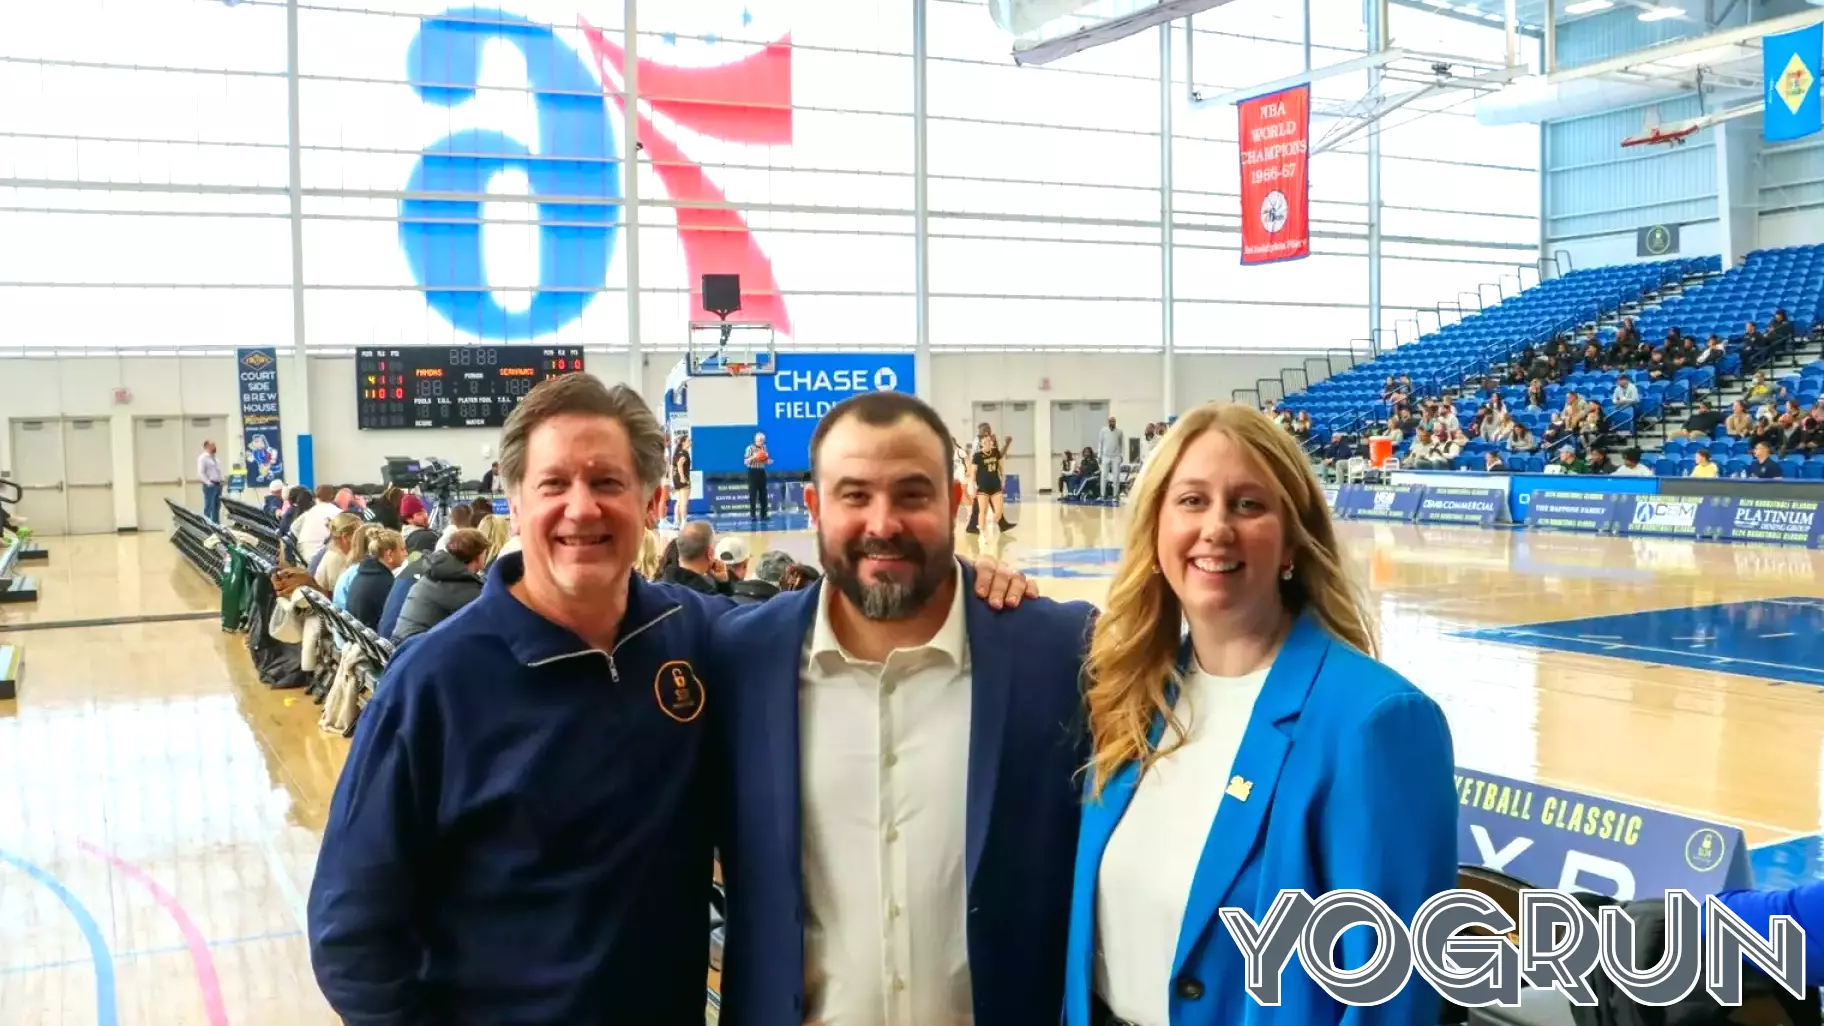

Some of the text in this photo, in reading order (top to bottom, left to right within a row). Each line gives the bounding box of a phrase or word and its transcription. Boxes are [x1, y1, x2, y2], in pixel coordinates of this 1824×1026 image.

[1260, 101, 1286, 120] NBA
[1251, 121, 1296, 142] WORLD
[1241, 139, 1306, 165] CHAMPIONS
[1251, 163, 1296, 184] 1966-67
[240, 371, 276, 381] COURT
[774, 369, 869, 392] CHASE
[248, 381, 270, 391] SIDE
[243, 392, 277, 402] BREW
[243, 403, 277, 412] HOUSE
[1734, 508, 1815, 525] PLATINUM
[1541, 797, 1643, 846] CLASSIC
